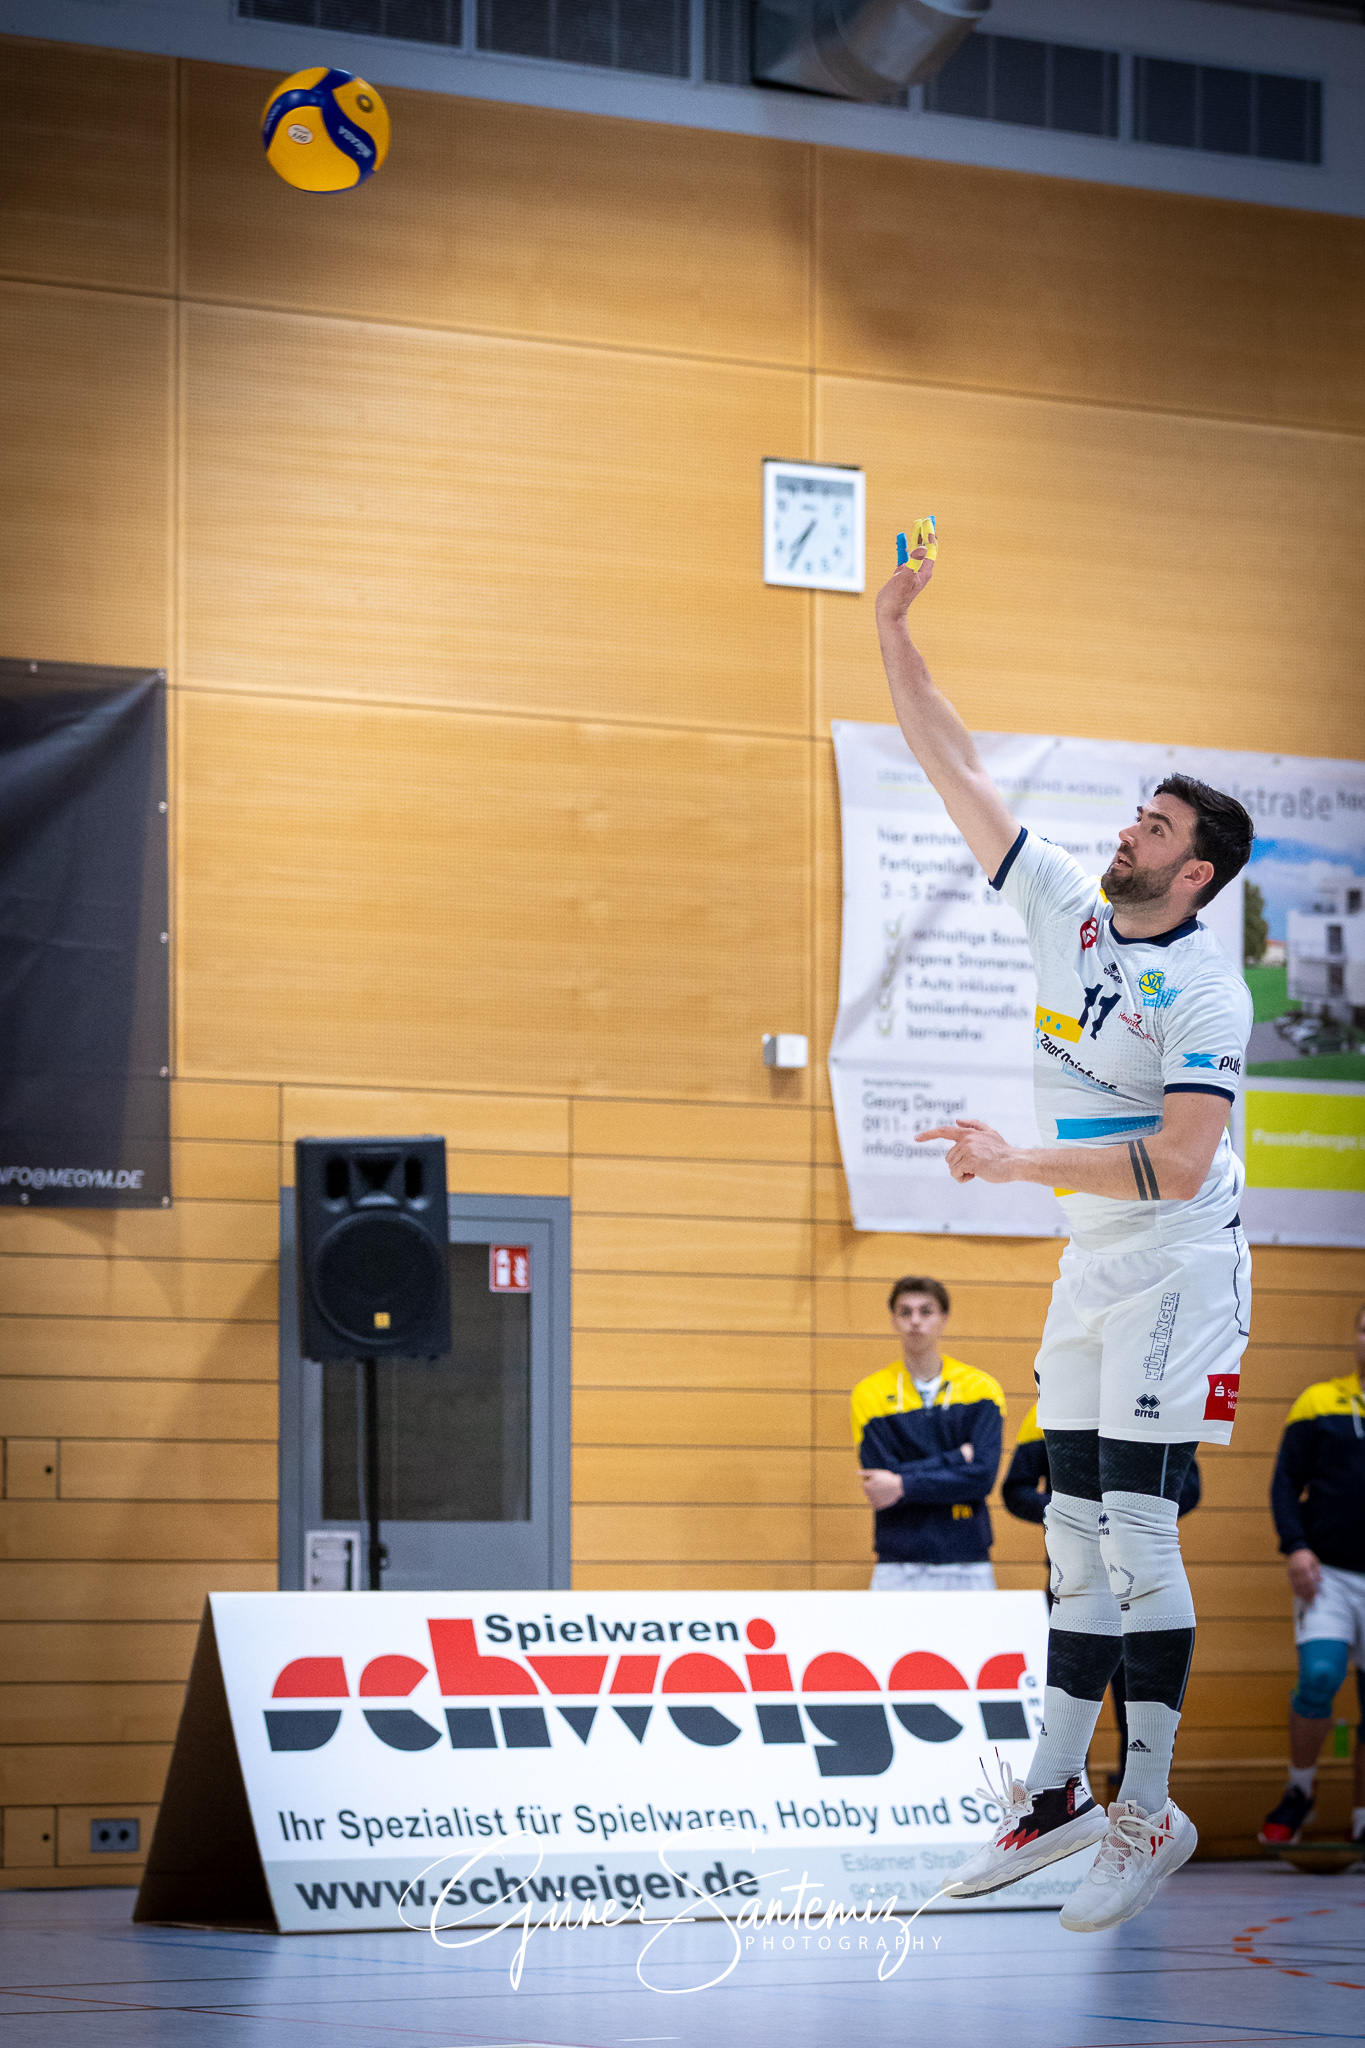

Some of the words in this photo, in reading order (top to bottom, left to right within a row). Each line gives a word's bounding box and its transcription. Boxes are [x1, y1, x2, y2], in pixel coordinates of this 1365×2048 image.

[1077, 983, 1122, 1040] 11
[1143, 1292, 1176, 1381] HÜTTINGER
[1134, 1408, 1160, 1419] errea
[484, 1613, 740, 1650] Spielwaren
[263, 1617, 1031, 1777] schweiger
[278, 1810, 325, 1842] Ihr
[337, 1807, 508, 1847] Spezialist
[516, 1805, 562, 1837] für
[574, 1803, 769, 1841] Spielwaren,
[775, 1798, 880, 1835] Hobby
[892, 1796, 951, 1826] und
[295, 1861, 760, 1911] www.schweiger.de
